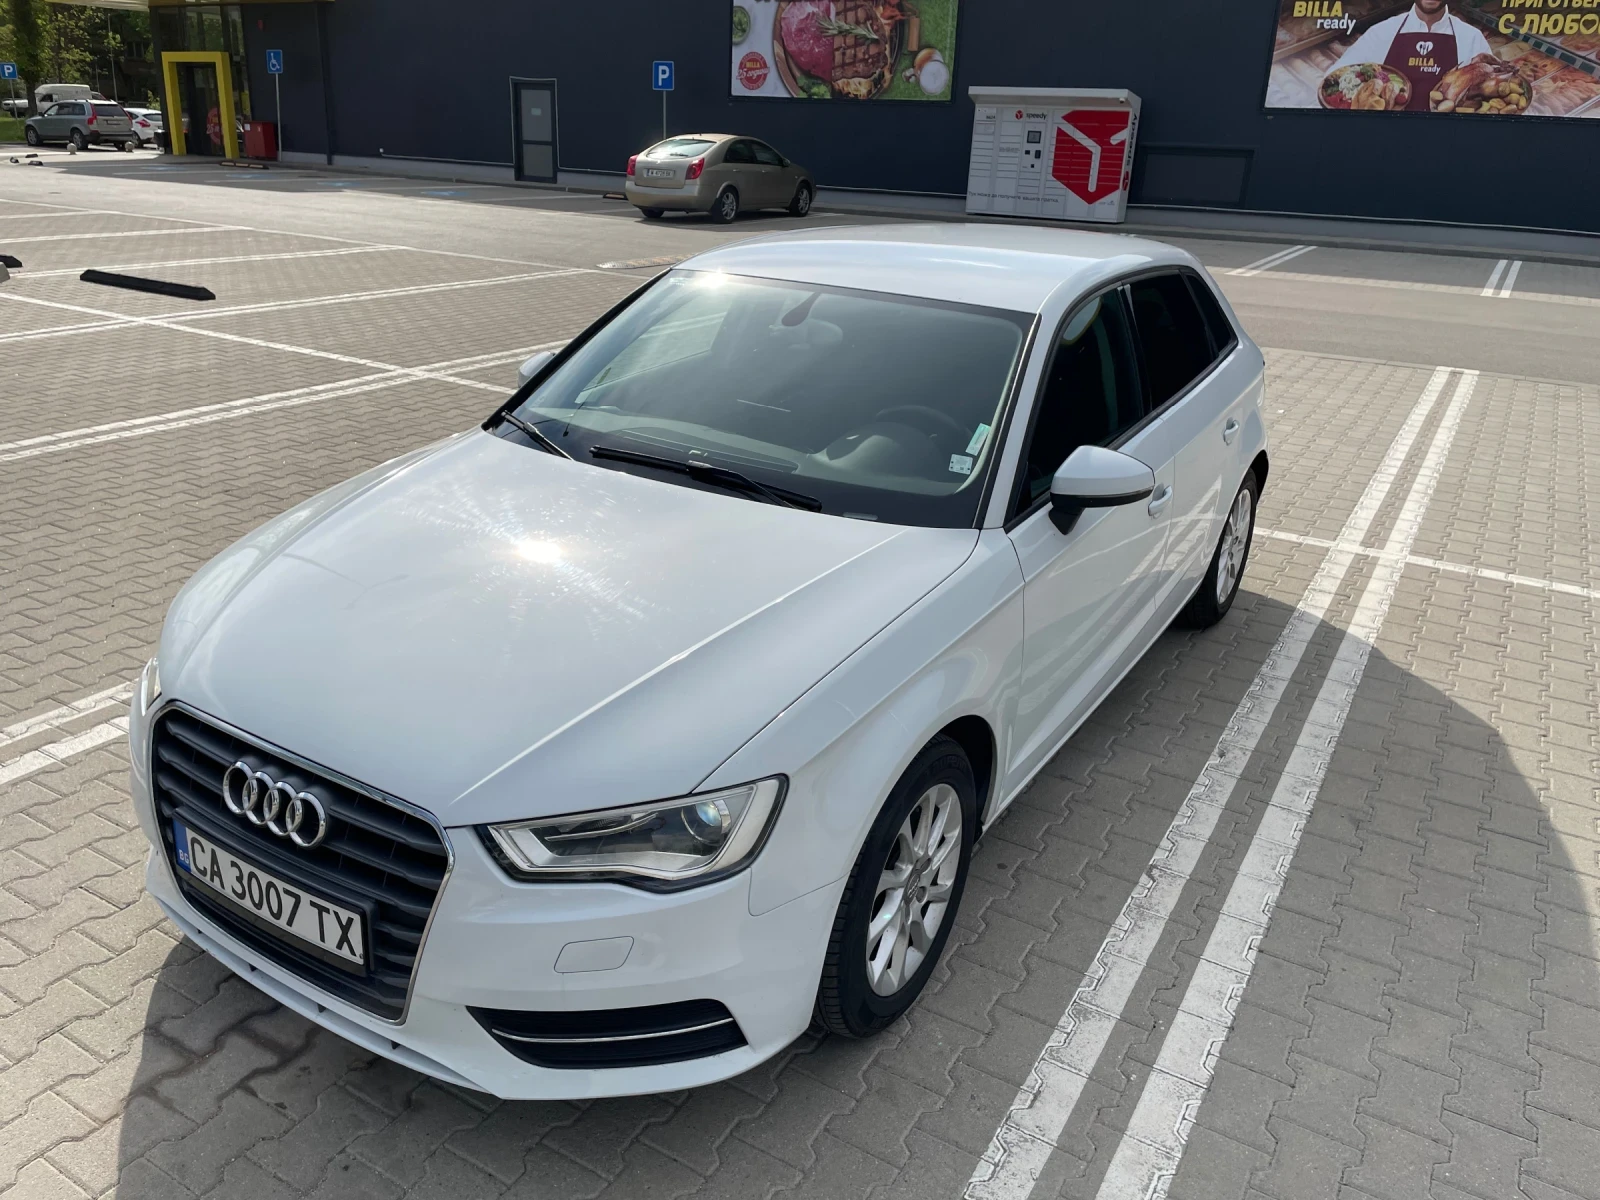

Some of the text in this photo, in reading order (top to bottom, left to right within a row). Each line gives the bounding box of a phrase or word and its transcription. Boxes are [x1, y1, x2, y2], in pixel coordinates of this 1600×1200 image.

[1293, 0, 1343, 17] BILLA
[1316, 12, 1356, 35] ready
[1498, 13, 1600, 35] С ЛЮБО
[1408, 57, 1434, 66] BILLA
[1420, 64, 1441, 75] ready
[3, 65, 13, 77] P
[659, 65, 669, 86] P
[1026, 112, 1047, 120] speedy
[1126, 113, 1138, 166] speedy
[179, 849, 190, 864] BG
[190, 836, 357, 957] CA 3007 TX
